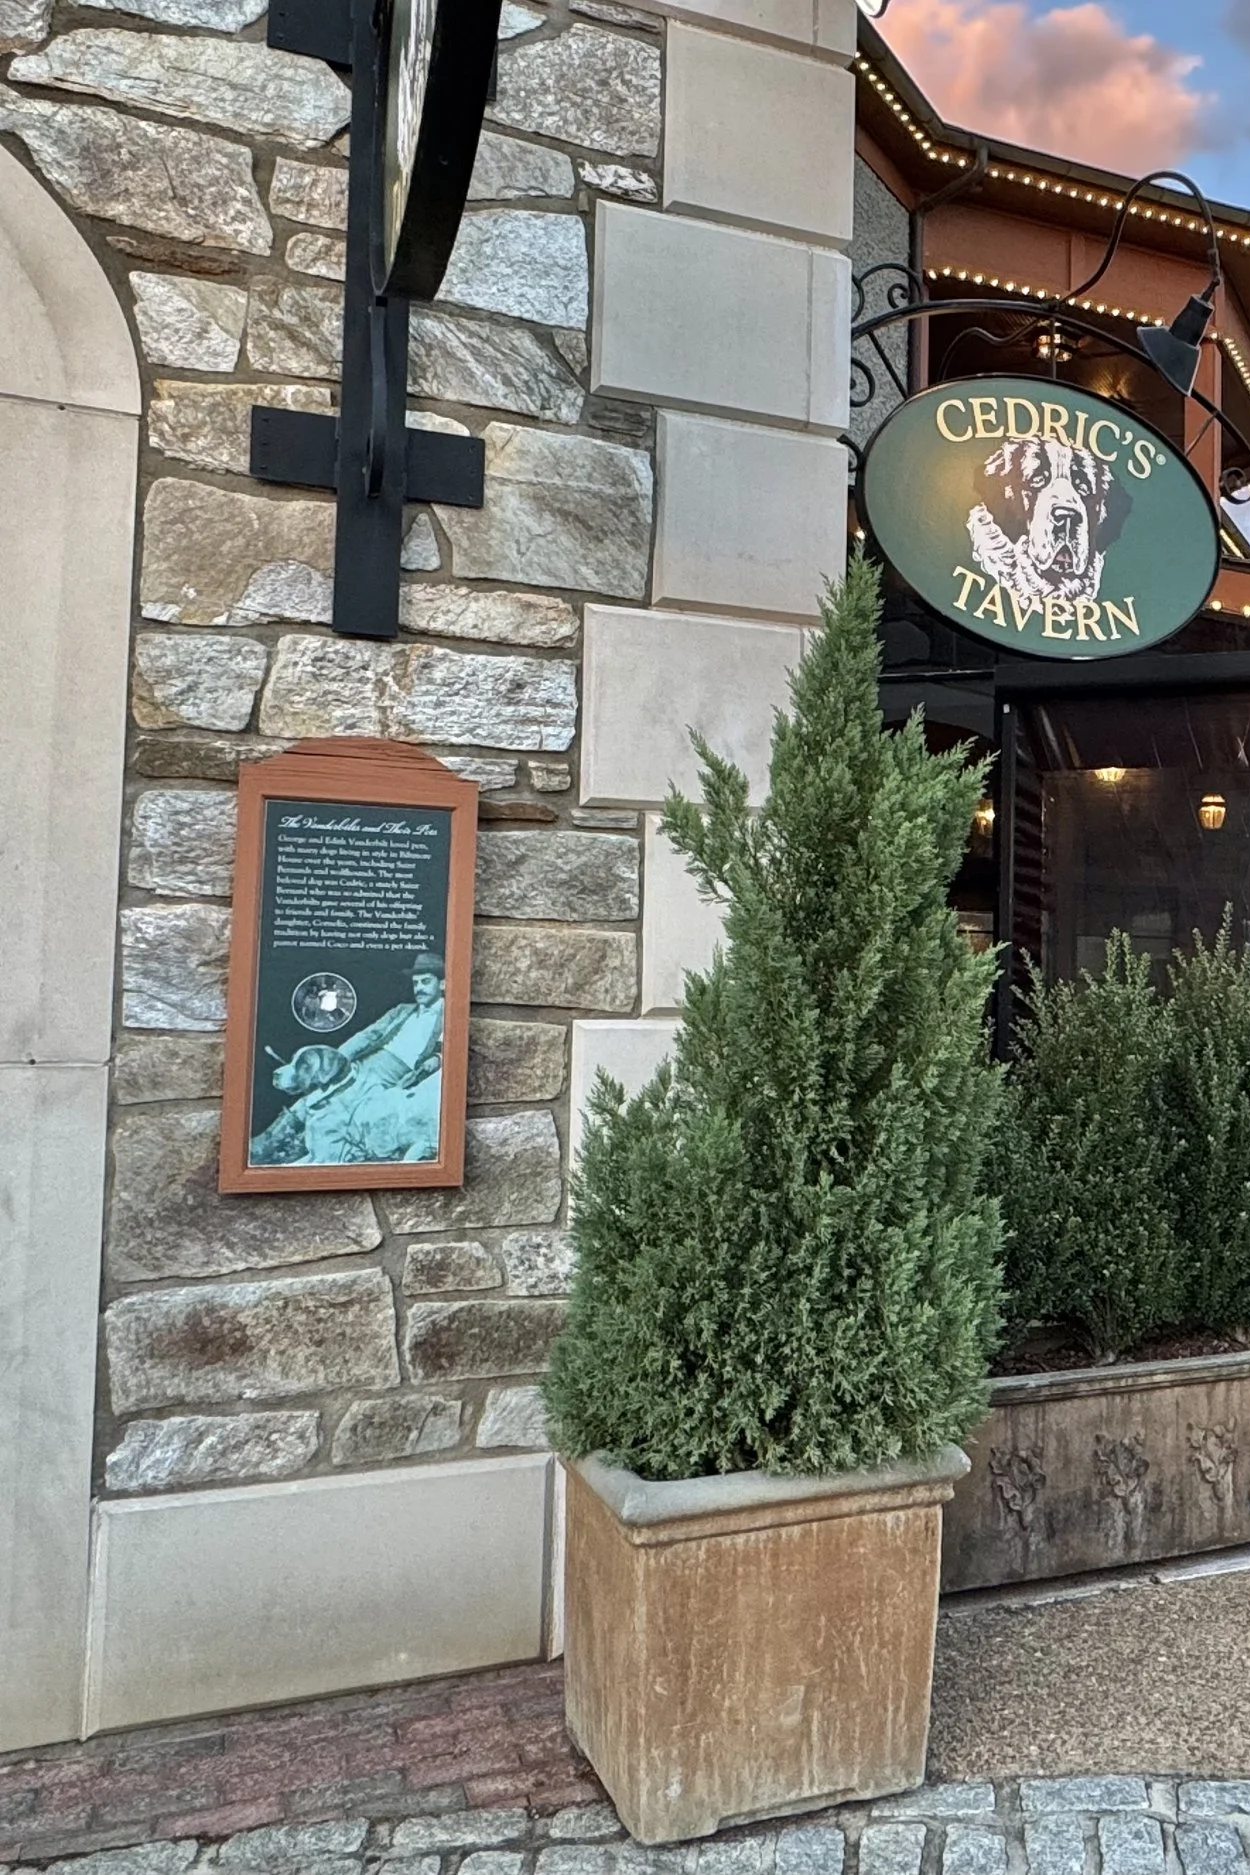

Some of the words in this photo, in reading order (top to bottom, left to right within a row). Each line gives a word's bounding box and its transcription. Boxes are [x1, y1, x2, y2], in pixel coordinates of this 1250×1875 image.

[936, 397, 1155, 480] CEDRIC'S
[952, 566, 1140, 641] TAVERN
[278, 815, 303, 828] The
[302, 816, 361, 831] Vanderbilts
[362, 822, 386, 832] and
[382, 821, 411, 834] Their
[412, 824, 437, 835] Pets
